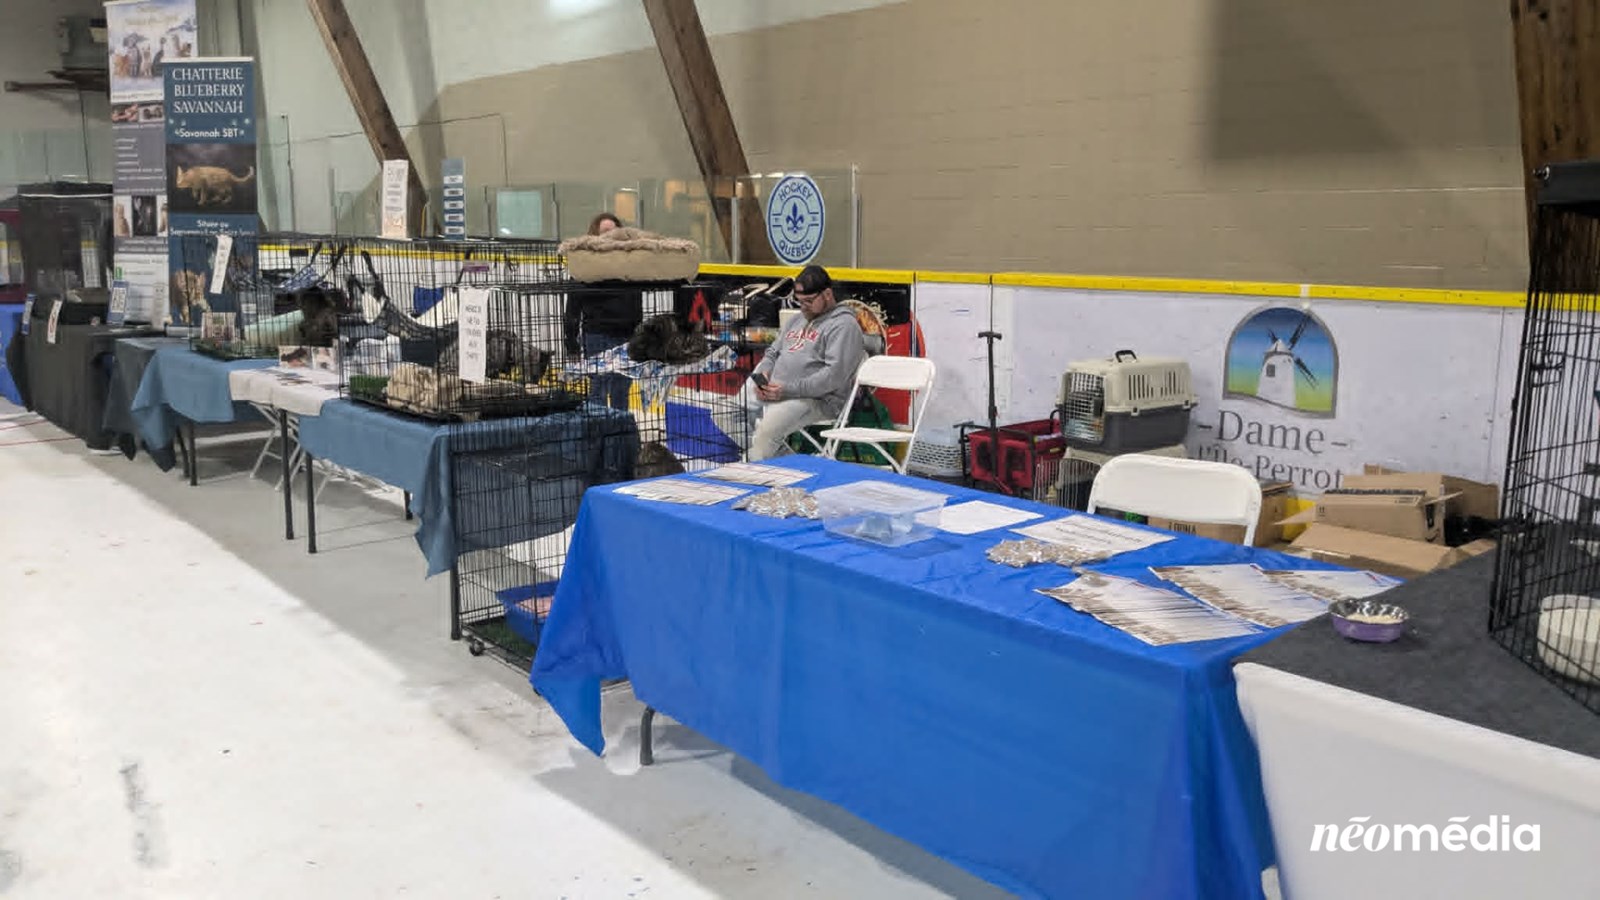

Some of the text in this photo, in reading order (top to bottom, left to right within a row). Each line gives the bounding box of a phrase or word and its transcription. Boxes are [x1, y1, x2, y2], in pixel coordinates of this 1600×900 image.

[172, 67, 244, 81] CHATTERIE
[174, 84, 245, 97] BLUEBERRY
[173, 101, 244, 114] SAVANNAH
[179, 127, 239, 138] Savannah SBT
[778, 182, 813, 201] HOCKEY
